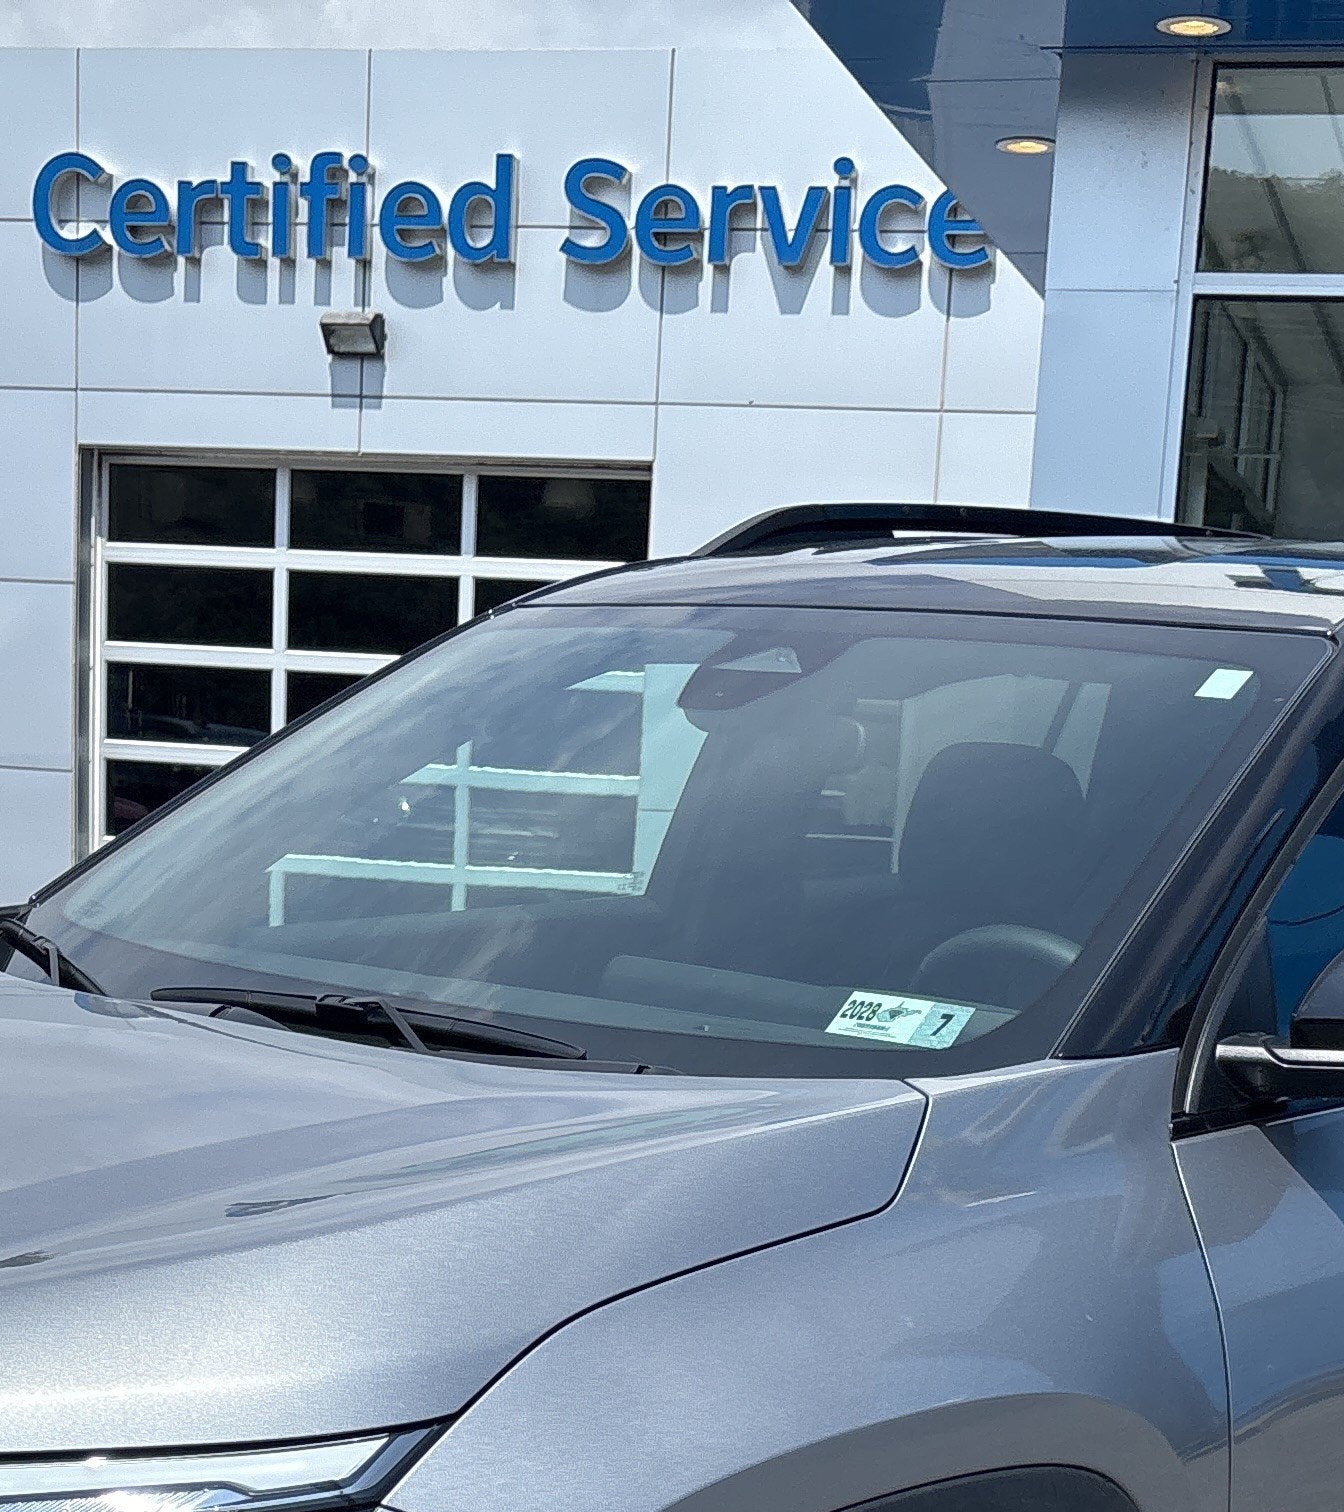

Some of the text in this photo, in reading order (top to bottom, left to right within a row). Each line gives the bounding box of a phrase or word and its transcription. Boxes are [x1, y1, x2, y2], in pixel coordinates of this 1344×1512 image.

[32, 151, 991, 270] Certified Service
[839, 999, 956, 1037] 2028 7
